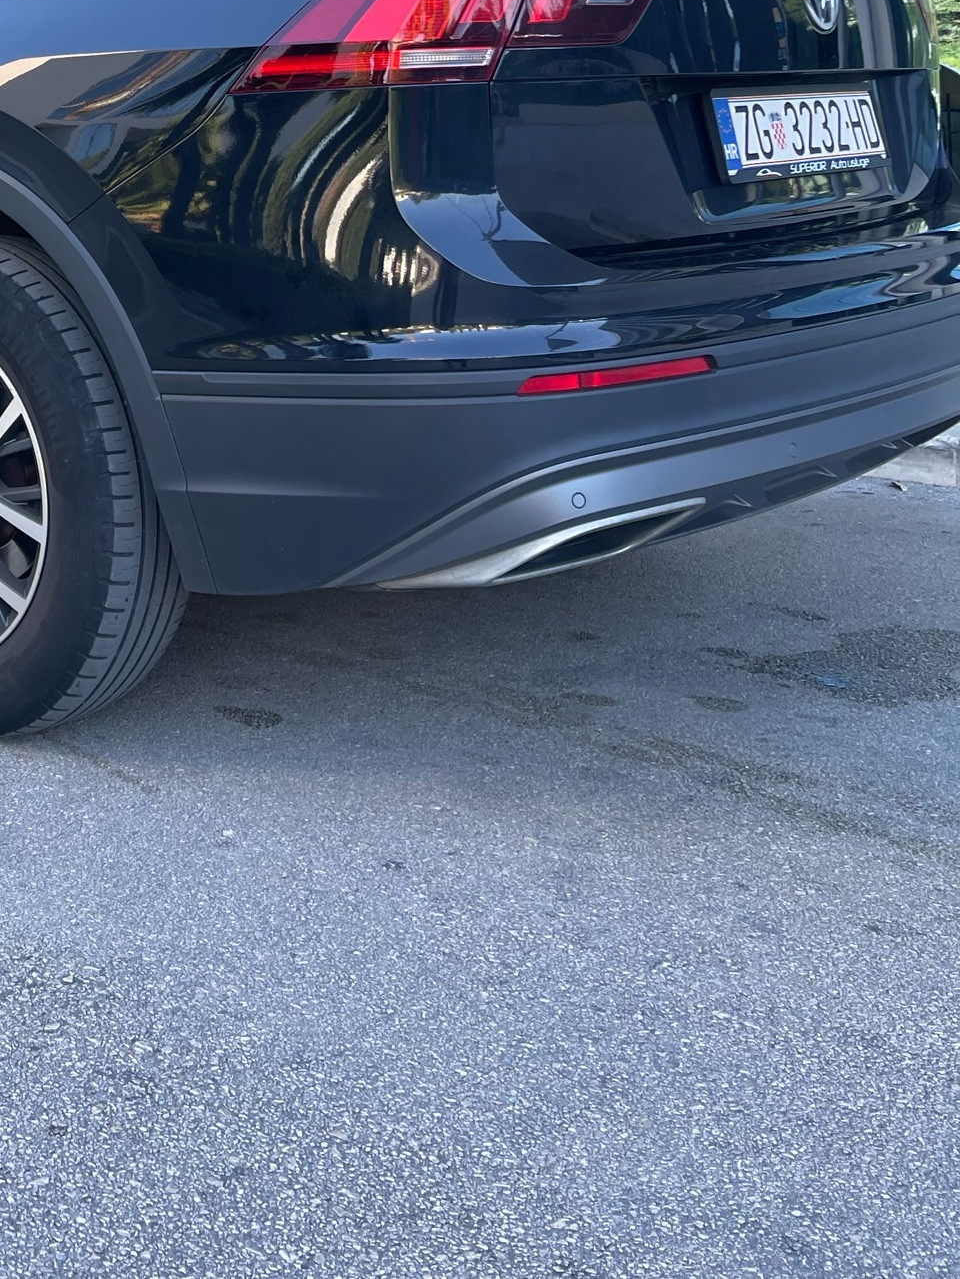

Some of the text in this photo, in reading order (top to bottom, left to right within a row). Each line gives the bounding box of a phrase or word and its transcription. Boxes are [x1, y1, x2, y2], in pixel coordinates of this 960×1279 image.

[735, 104, 774, 160] ZG
[724, 143, 740, 160] HR
[790, 161, 827, 174] SUPERIOR
